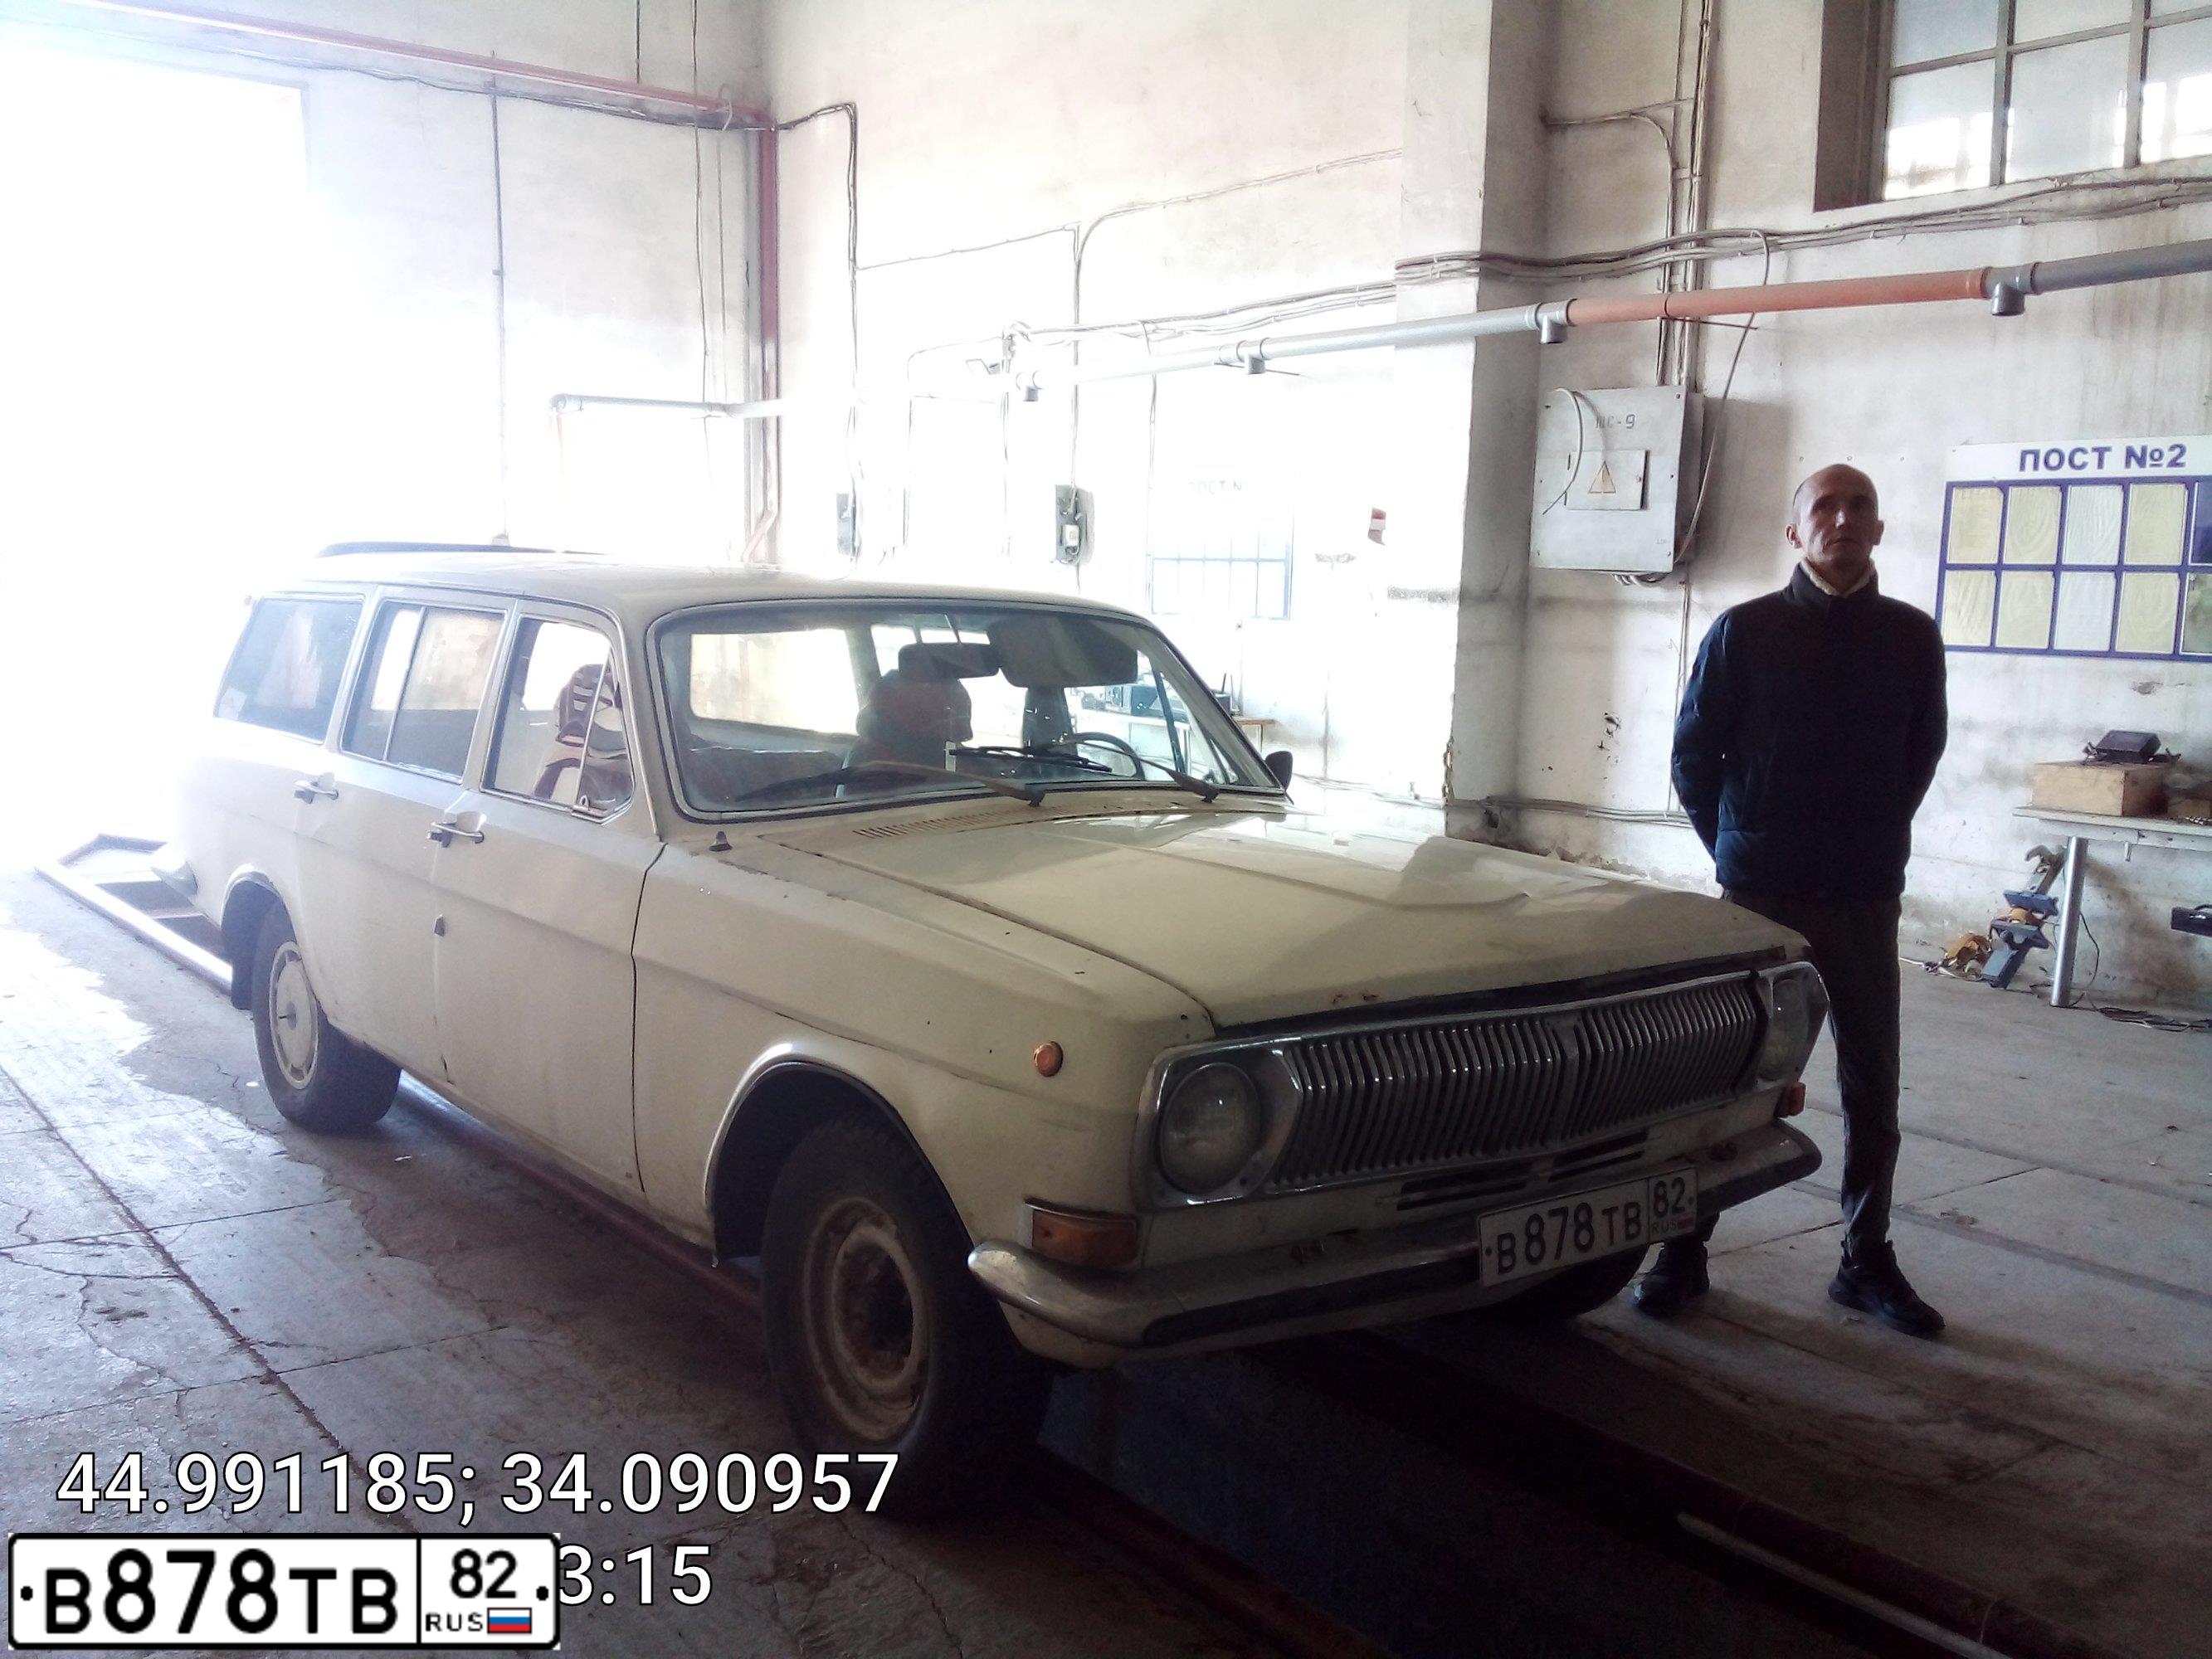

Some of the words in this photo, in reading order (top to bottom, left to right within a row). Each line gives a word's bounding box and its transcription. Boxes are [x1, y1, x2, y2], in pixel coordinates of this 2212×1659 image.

[2019, 445, 2112, 472] ПОСТ
[2124, 443, 2187, 469] №2
[1497, 1202, 1641, 1275] В878ТВ
[1653, 1176, 1687, 1219] 82
[1652, 1221, 1677, 1234] RUS
